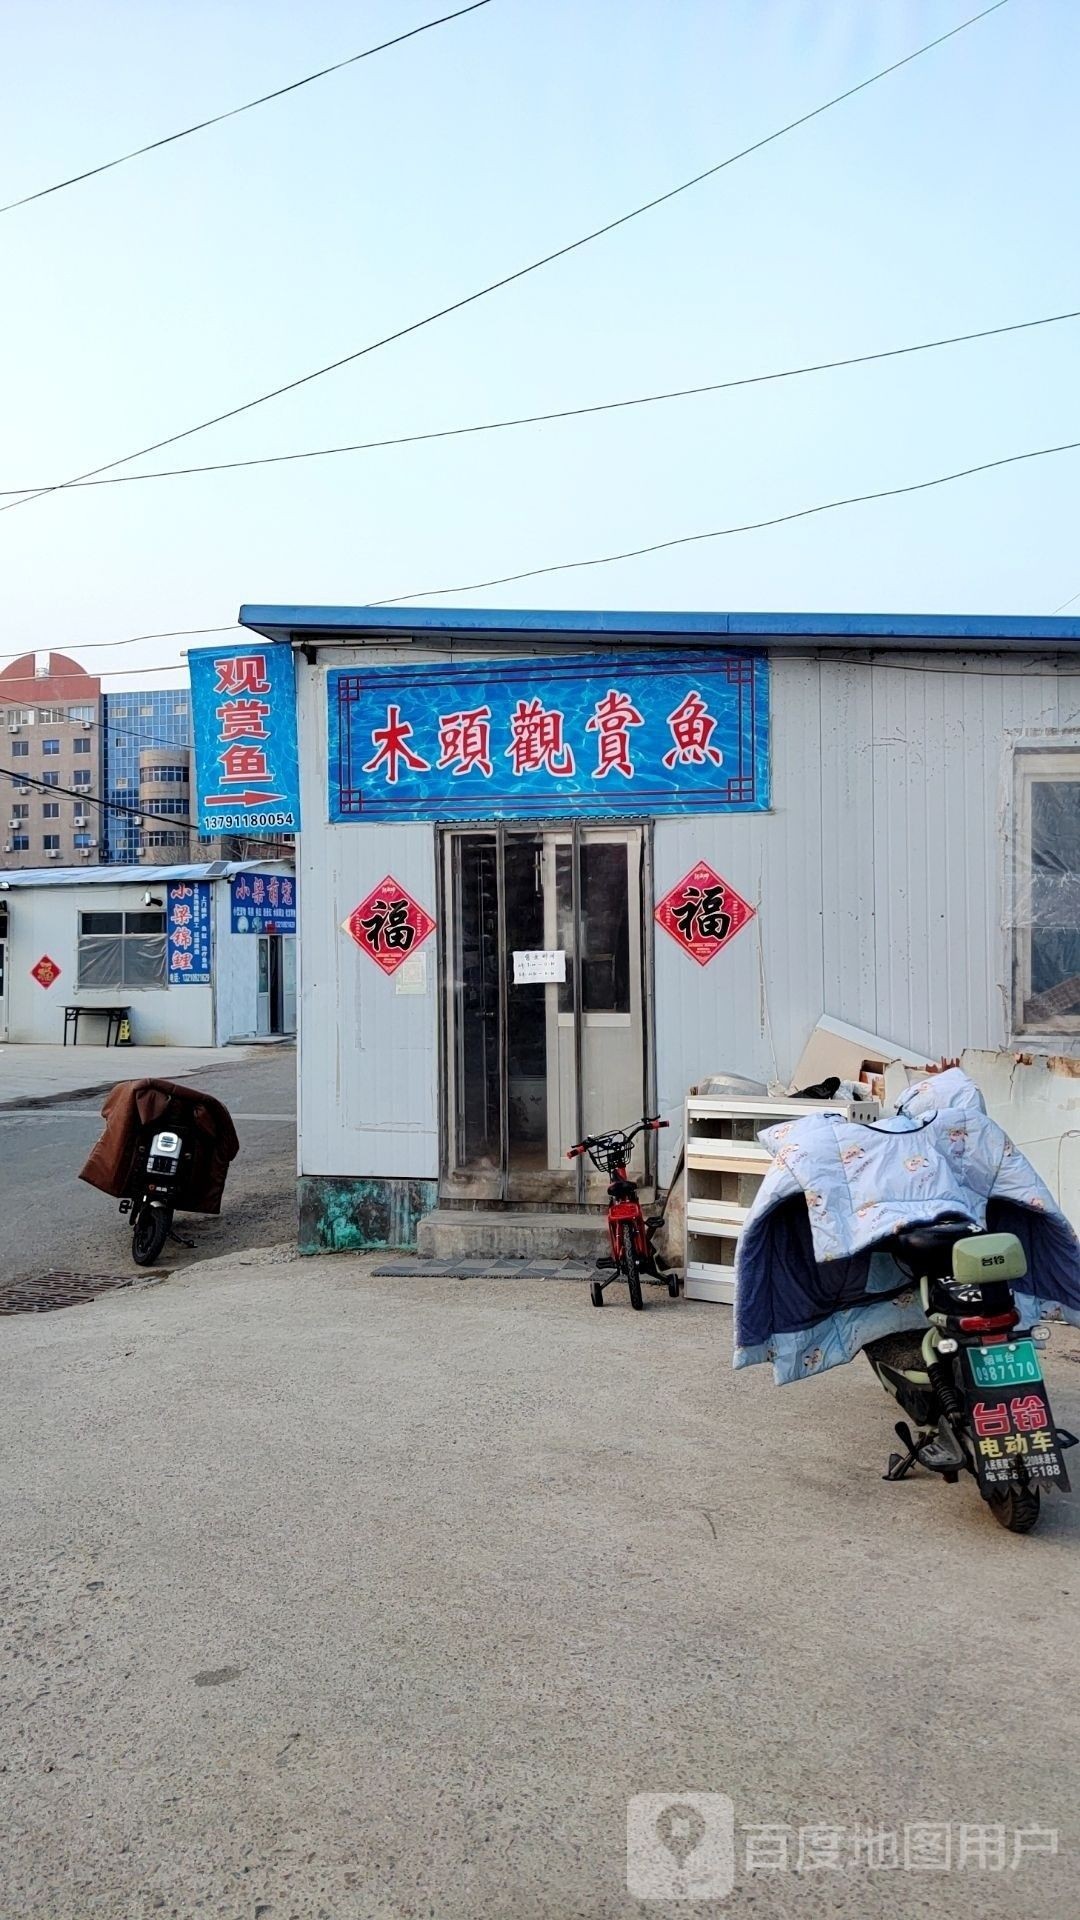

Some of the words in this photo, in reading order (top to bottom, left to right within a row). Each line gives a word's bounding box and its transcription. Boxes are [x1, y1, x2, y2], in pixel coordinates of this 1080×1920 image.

[213, 654, 274, 785] 观赏鱼
[362, 688, 723, 784] 木頭觀賞魚
[204, 813, 294, 830] 13791180054
[169, 882, 193, 971] 小梁锦鲤
[359, 898, 417, 952] 福
[670, 884, 732, 942] 福
[972, 1395, 1048, 1437] 台铃
[979, 1430, 1054, 1458] 电动车
